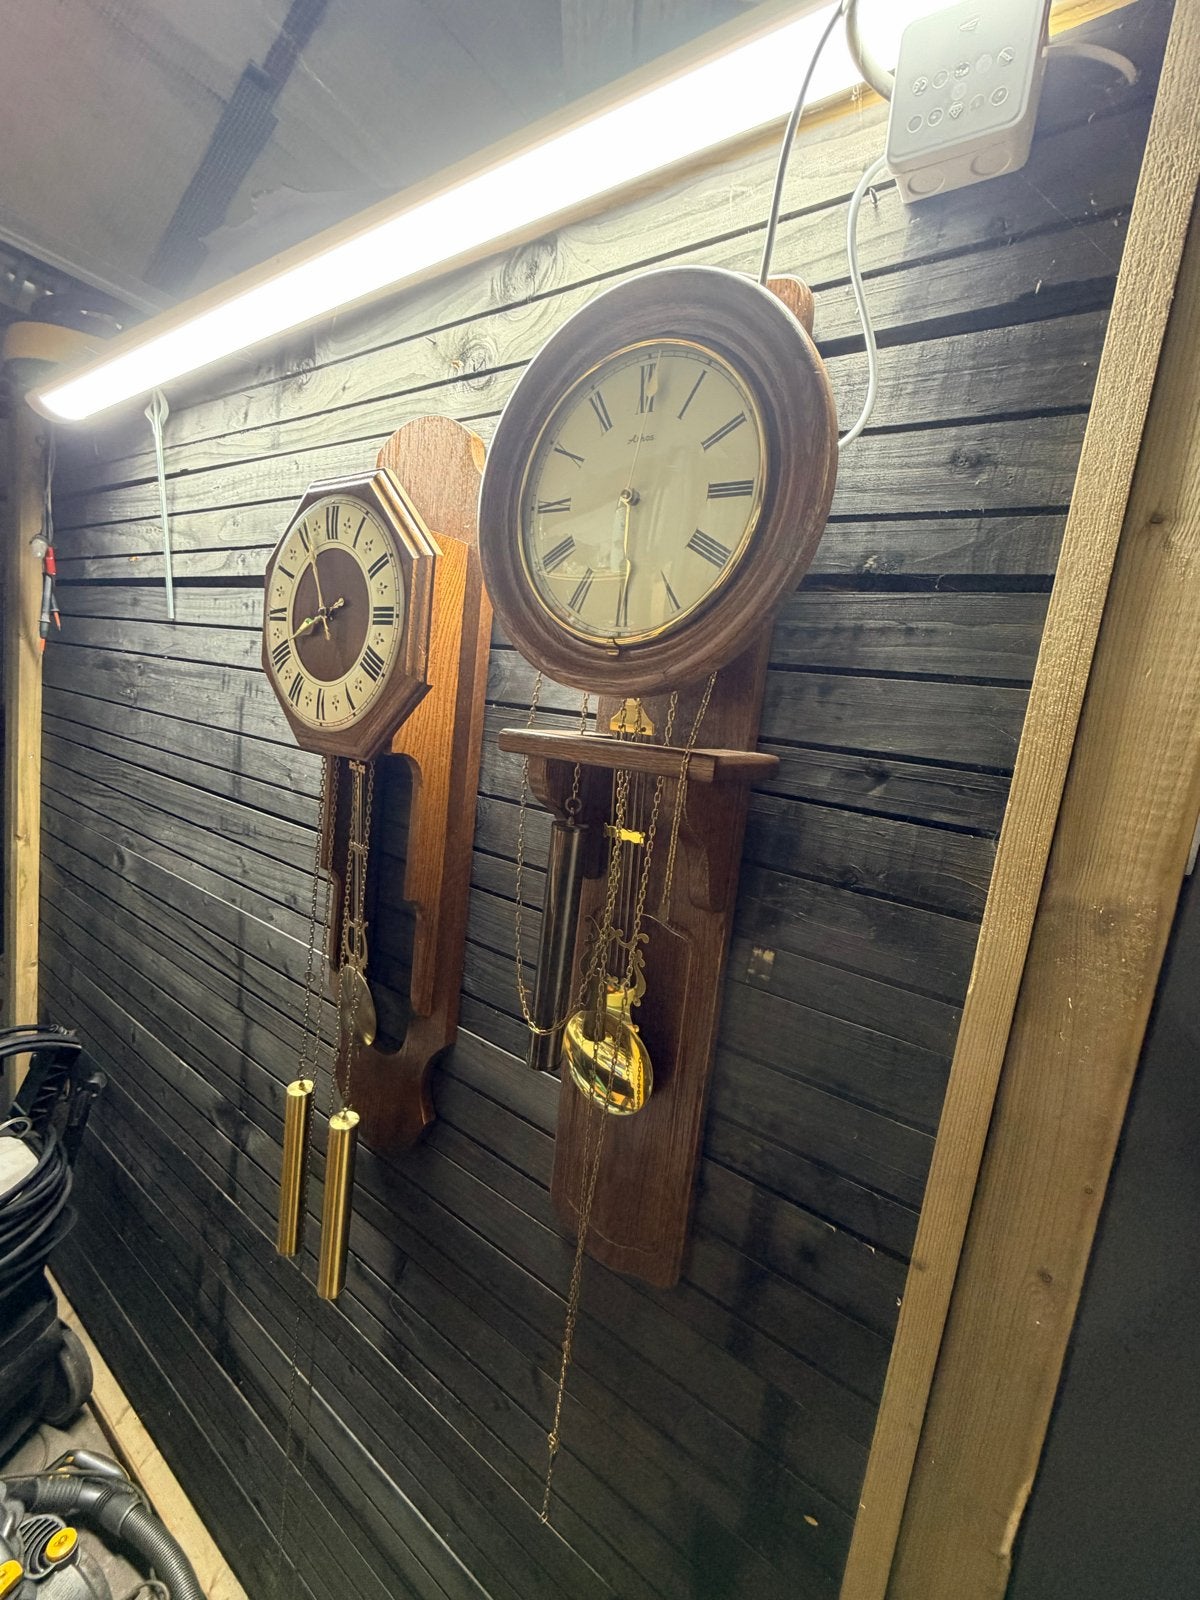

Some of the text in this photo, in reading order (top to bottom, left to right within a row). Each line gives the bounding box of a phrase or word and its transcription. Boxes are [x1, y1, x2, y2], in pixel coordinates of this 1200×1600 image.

[678, 370, 708, 419] I
[700, 412, 747, 451] II
[706, 478, 755, 499] III
[352, 516, 367, 549] I
[686, 528, 732, 569] IIII
[367, 552, 390, 580] II
[372, 606, 395, 626] III
[359, 645, 385, 682] IIII
